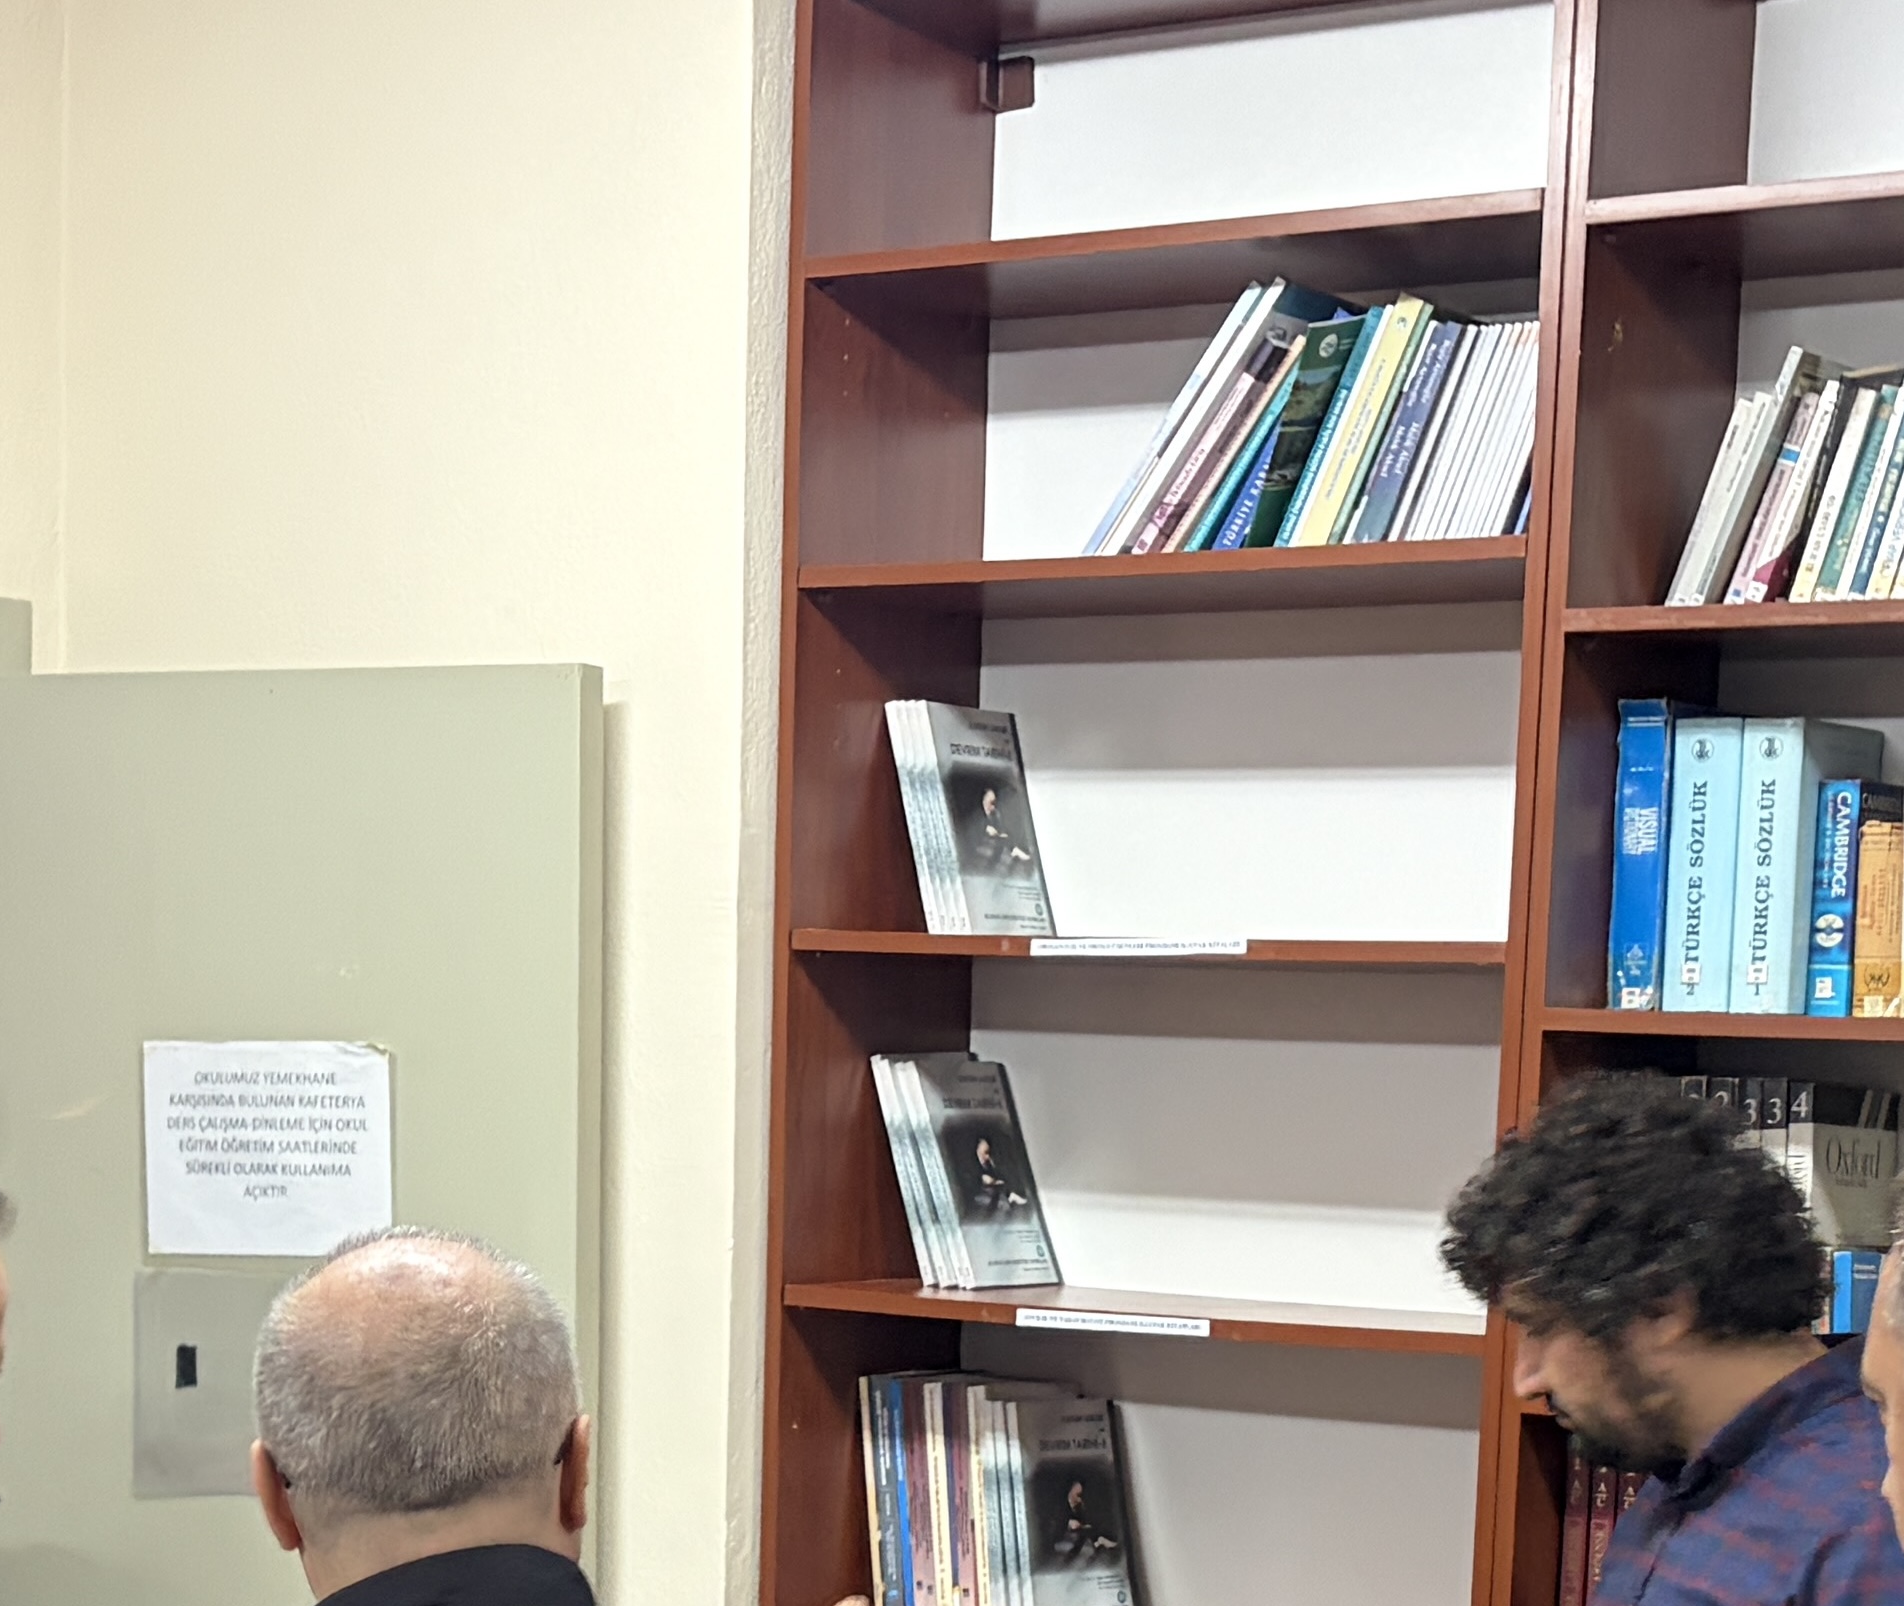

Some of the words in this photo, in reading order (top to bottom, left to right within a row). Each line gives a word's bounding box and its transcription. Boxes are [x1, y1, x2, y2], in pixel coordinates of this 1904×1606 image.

[1639, 807, 1658, 855] VISUAL
[1689, 781, 1709, 867] SÖZLÜK
[1757, 778, 1777, 867] SÖZLÜK
[1831, 790, 1853, 898] CAMBRIDGE
[1683, 876, 1704, 965] TÜRKÇE
[1748, 875, 1771, 965] TÜRKÇE
[195, 1072, 259, 1085] OKULUMUZ
[263, 1072, 337, 1085] YEMEKHANE
[169, 1094, 235, 1109] KARŞISINDA
[239, 1094, 294, 1108] BULUNAN
[298, 1095, 365, 1108] KAFETERYA
[1767, 1098, 1782, 1124] 3
[1790, 1091, 1808, 1118] 4
[167, 1117, 195, 1130] DERS
[308, 1116, 332, 1133] İÇİN
[336, 1118, 368, 1131] OKUL
[221, 1137, 274, 1153] ÖĞRETİM
[278, 1141, 357, 1154] SAATLERİNDE
[1825, 1135, 1881, 1180] Oxford
[186, 1160, 230, 1175] SÜREKLİ
[234, 1162, 278, 1175] OLARAK
[244, 1185, 288, 1201] AÇIKTIR
